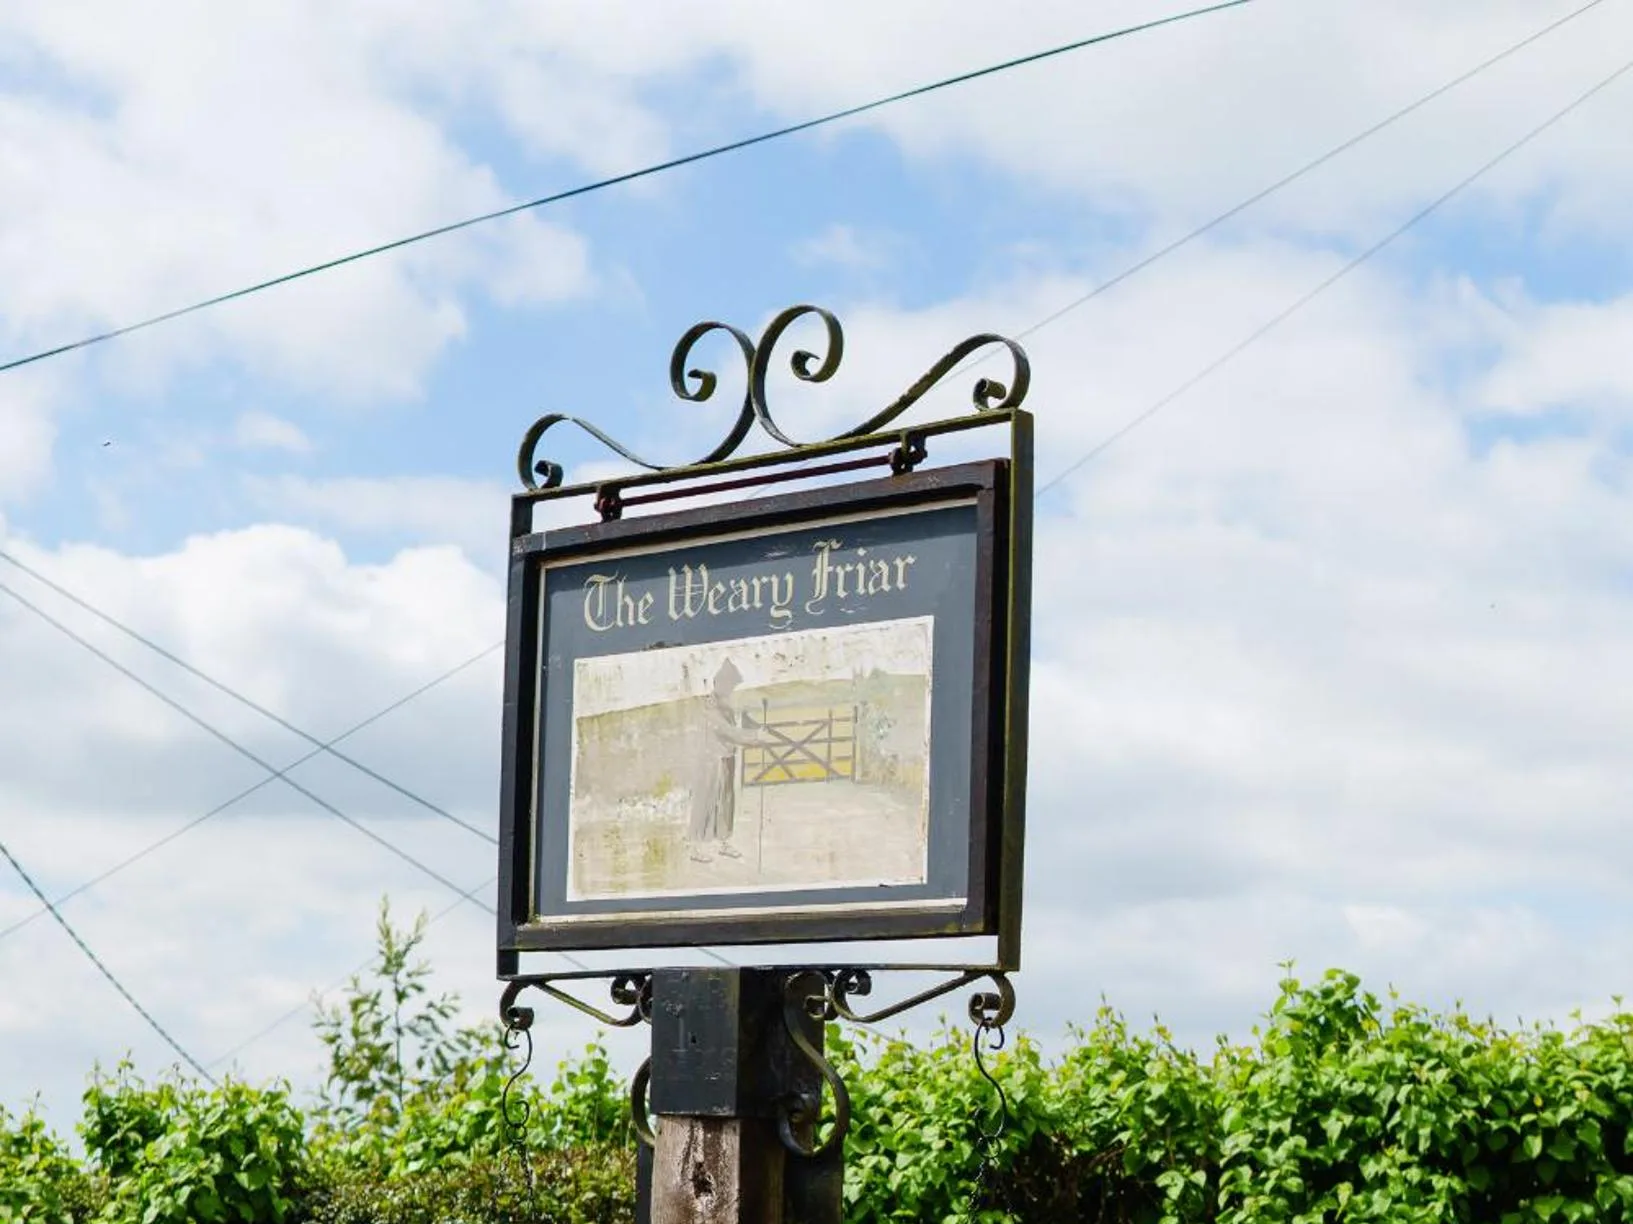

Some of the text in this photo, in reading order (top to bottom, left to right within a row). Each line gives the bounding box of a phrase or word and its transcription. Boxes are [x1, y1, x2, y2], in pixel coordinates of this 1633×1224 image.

[583, 538, 916, 632] The Weary Friar
